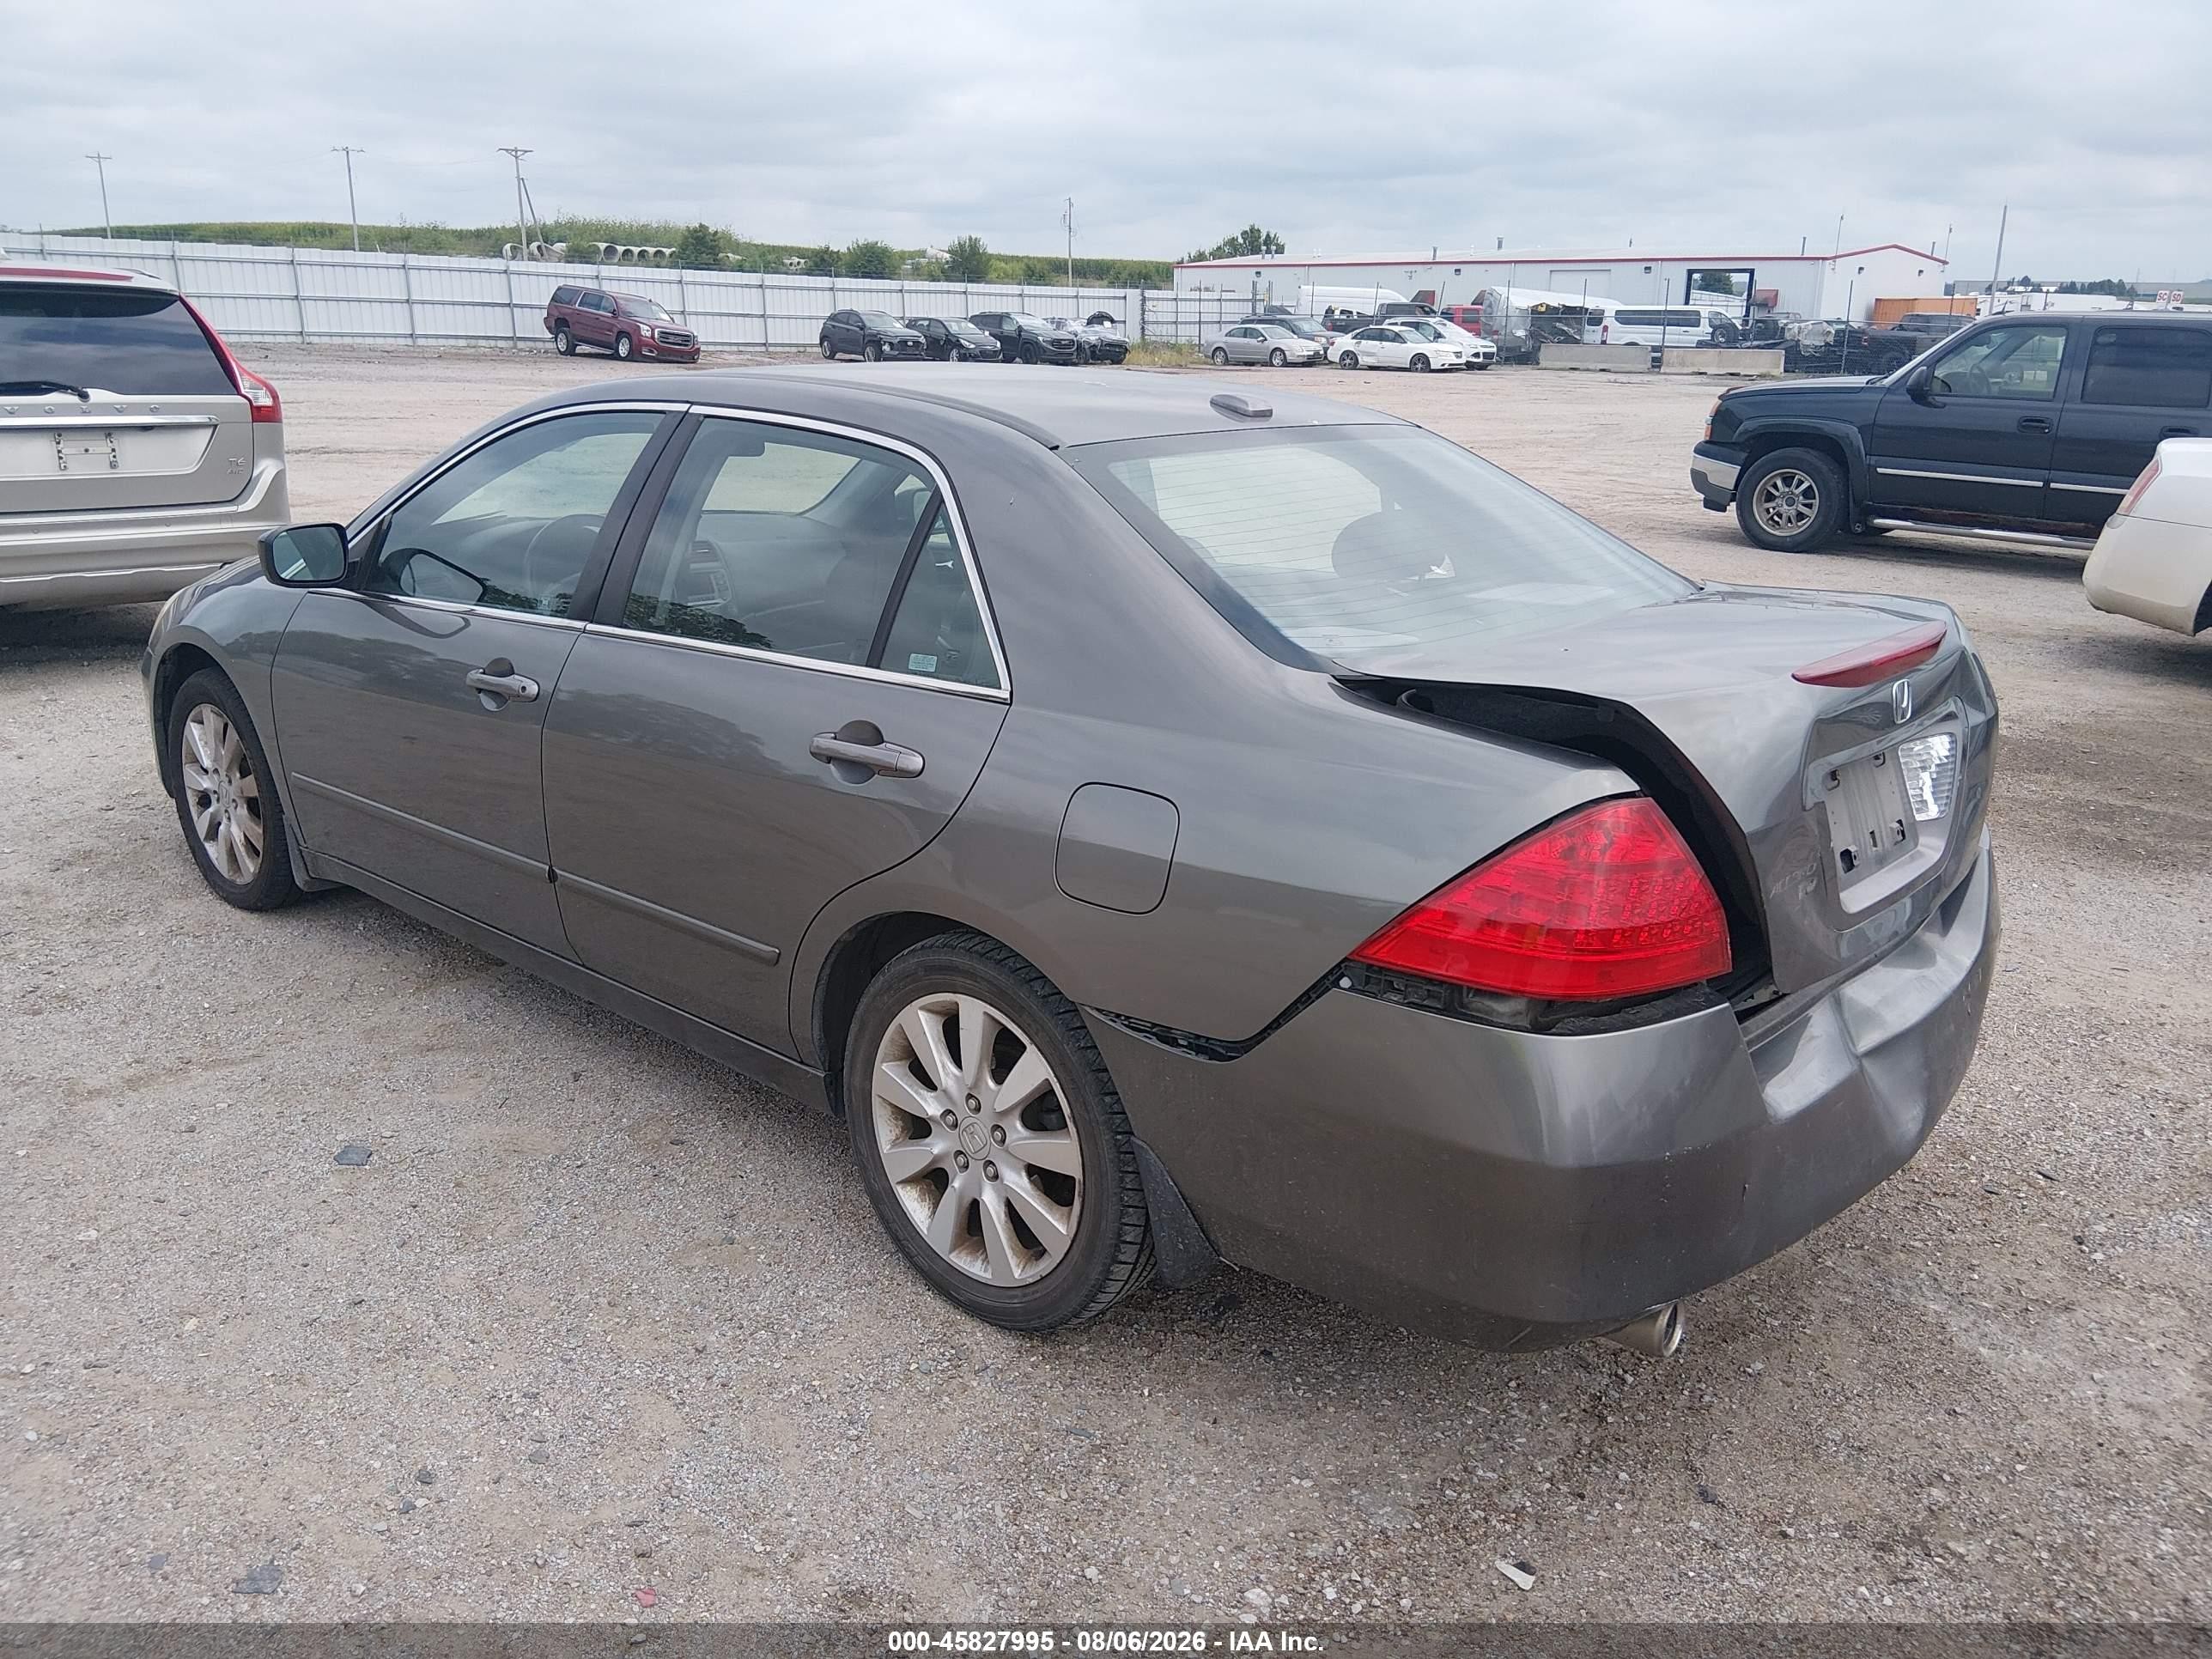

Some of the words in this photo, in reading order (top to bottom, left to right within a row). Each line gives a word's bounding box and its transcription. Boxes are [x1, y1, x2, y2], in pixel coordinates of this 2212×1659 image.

[2157, 292, 2167, 301] SC
[2171, 294, 2182, 302] SD
[3, 404, 160, 414] VOLVO
